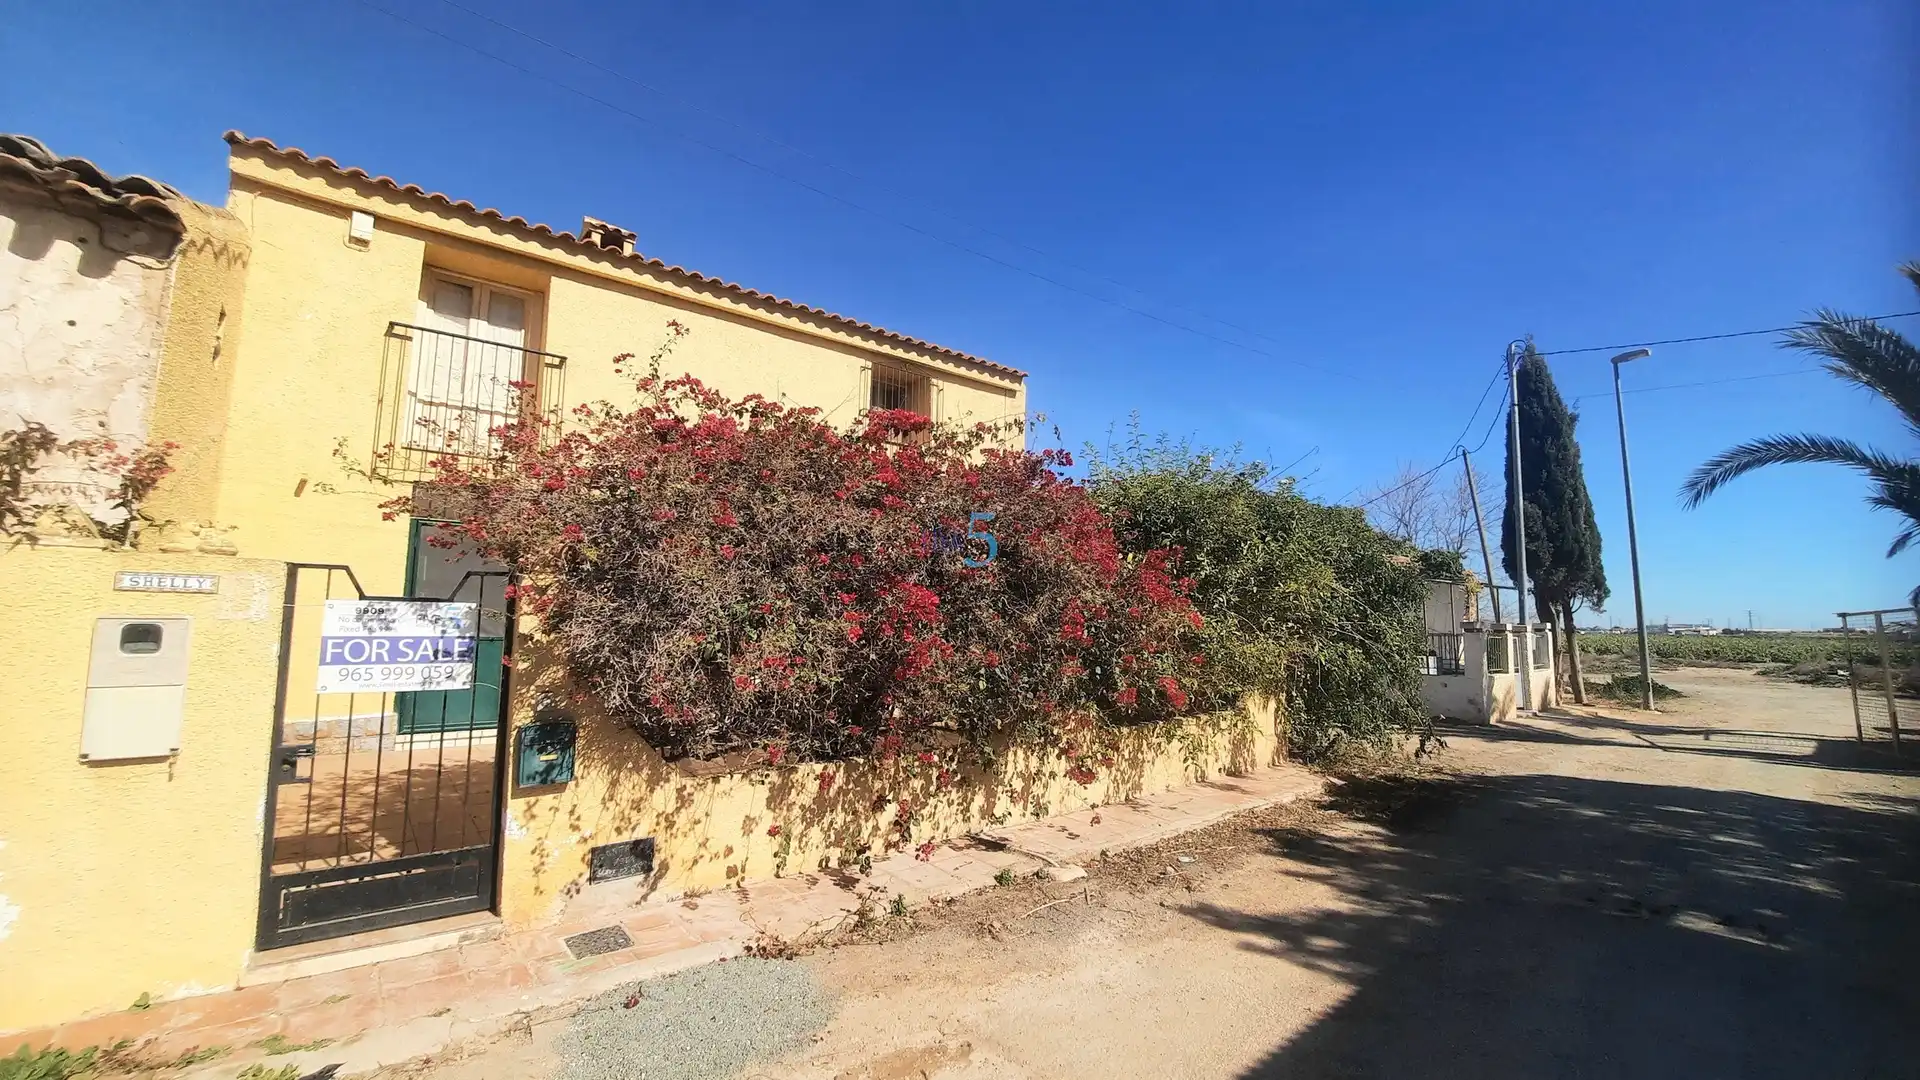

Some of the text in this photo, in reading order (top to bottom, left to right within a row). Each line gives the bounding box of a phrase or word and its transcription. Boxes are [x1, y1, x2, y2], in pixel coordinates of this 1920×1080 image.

[128, 576, 206, 588] SHELLY
[325, 638, 470, 663] FOR SALE
[338, 665, 455, 682] 965 999 059
